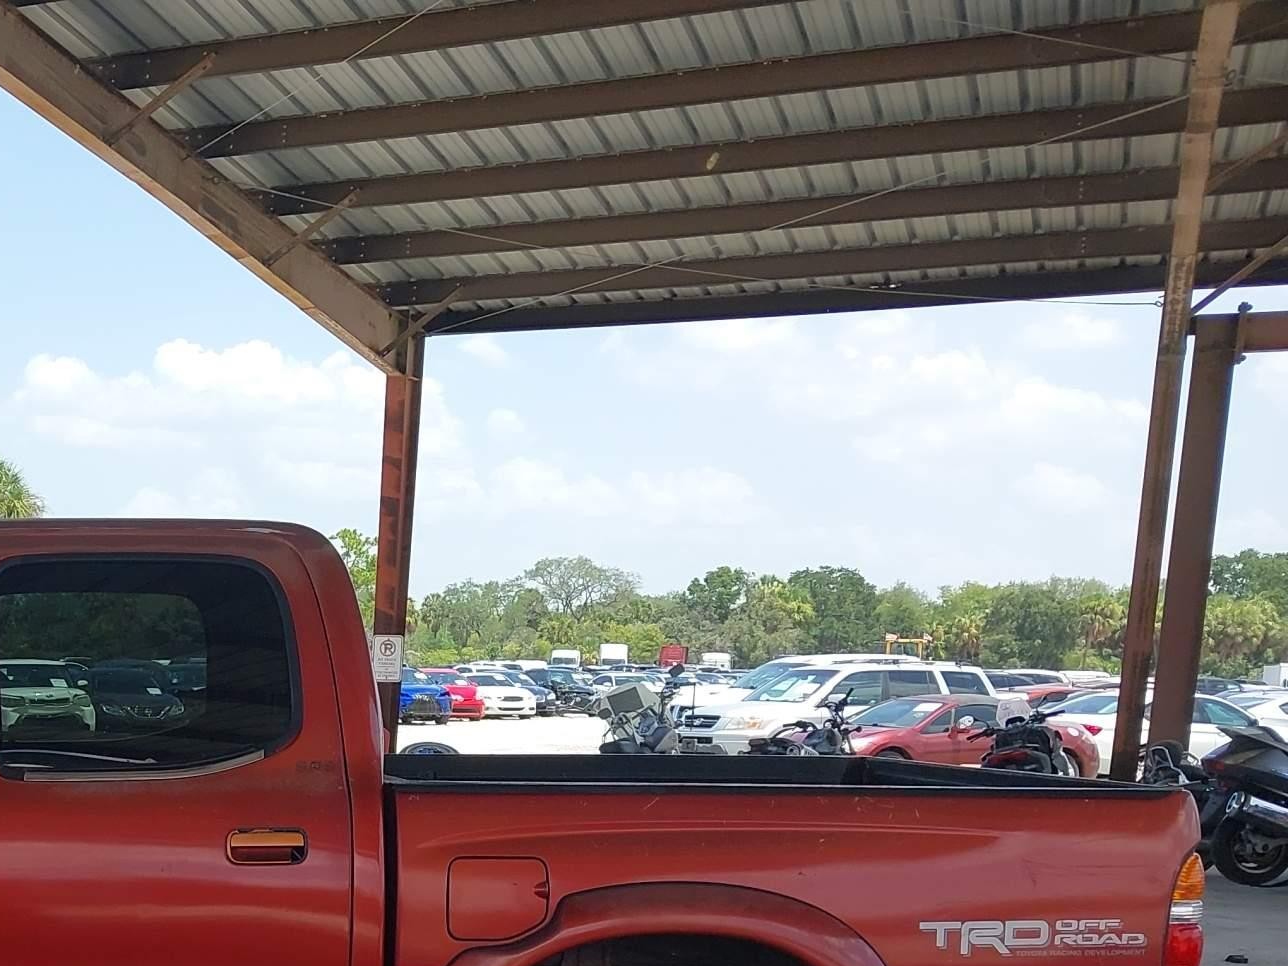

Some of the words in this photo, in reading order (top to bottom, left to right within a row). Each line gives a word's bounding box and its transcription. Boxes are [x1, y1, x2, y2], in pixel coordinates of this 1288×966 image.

[1055, 919, 1122, 932] OFF
[919, 919, 1050, 956] TRD
[1054, 933, 1146, 946] ROAD
[1015, 949, 1047, 957] TOYOTA
[1084, 949, 1145, 957] DEVELOPMENT
